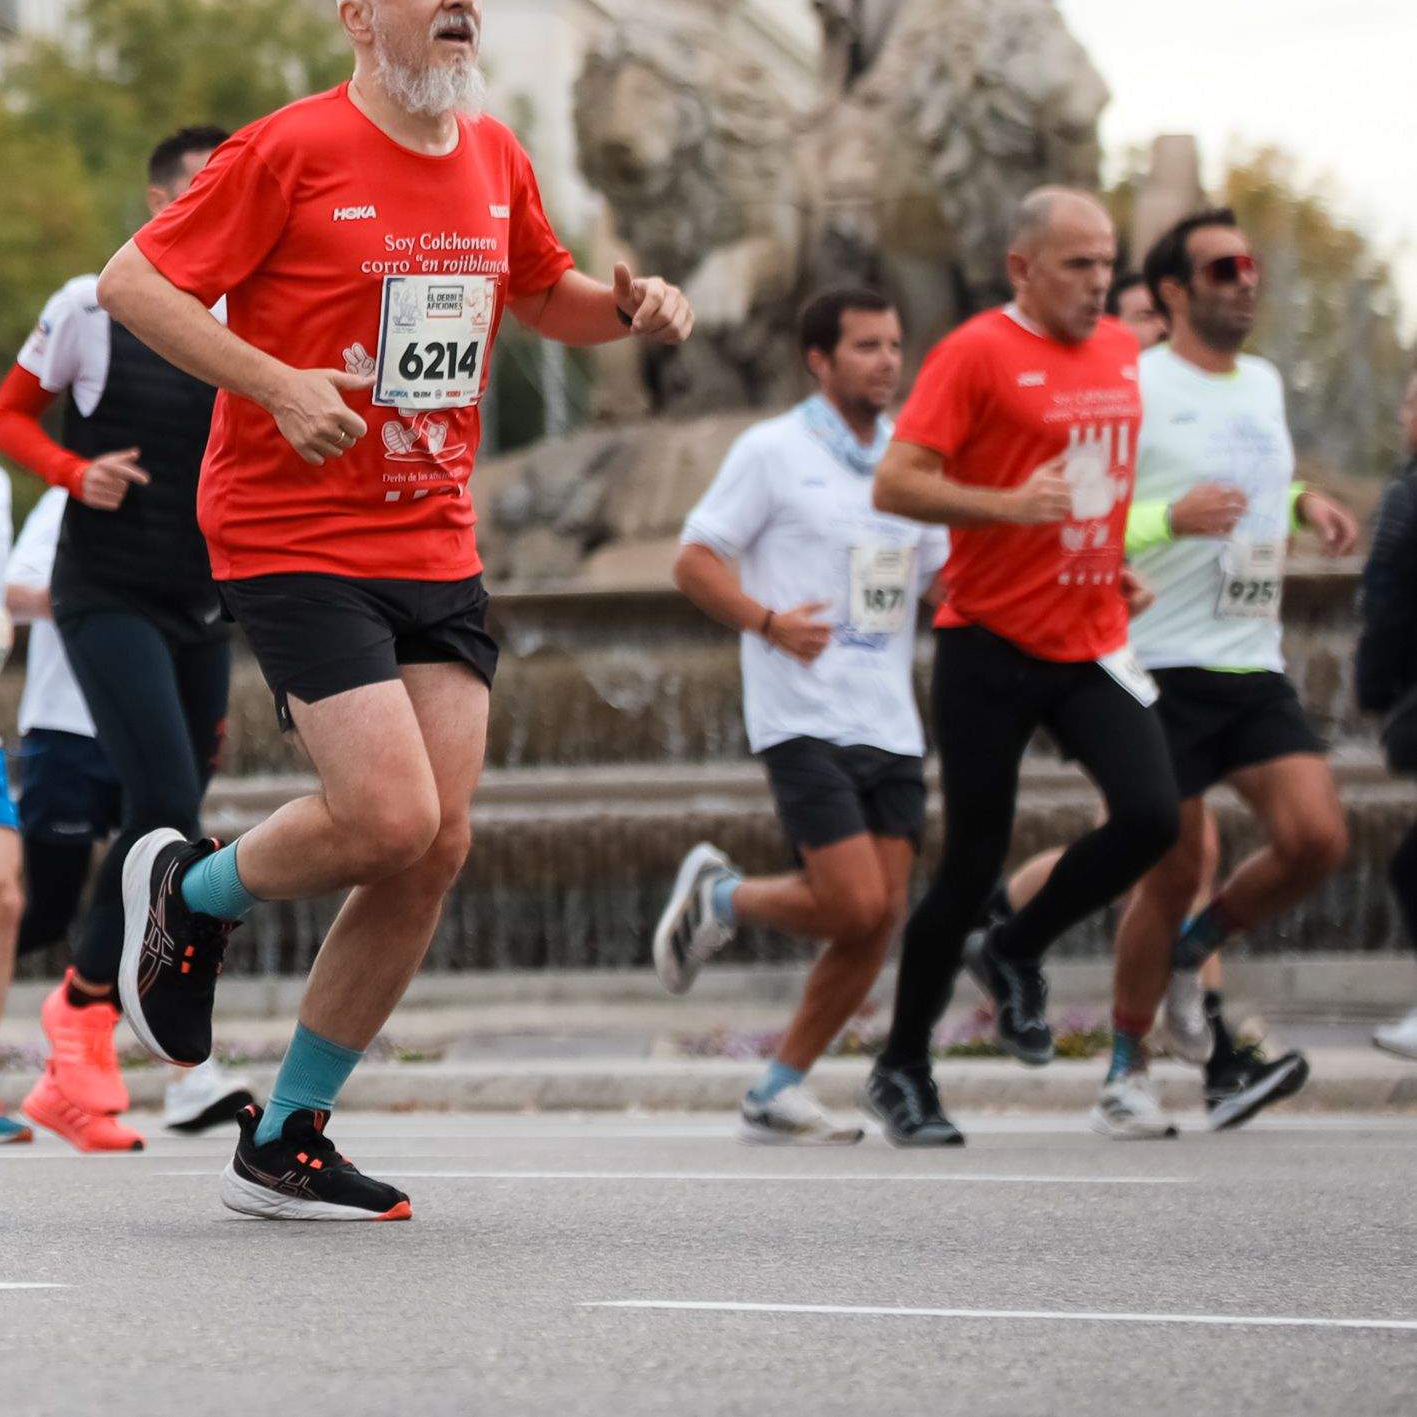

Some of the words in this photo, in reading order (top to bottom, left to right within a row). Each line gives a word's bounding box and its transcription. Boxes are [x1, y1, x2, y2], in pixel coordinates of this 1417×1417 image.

[333, 205, 376, 221] HOKA
[384, 235, 415, 255] Soy
[420, 232, 497, 251] Colchonero
[361, 259, 410, 273] corro
[398, 341, 479, 381] 6214
[408, 472, 417, 481] de
